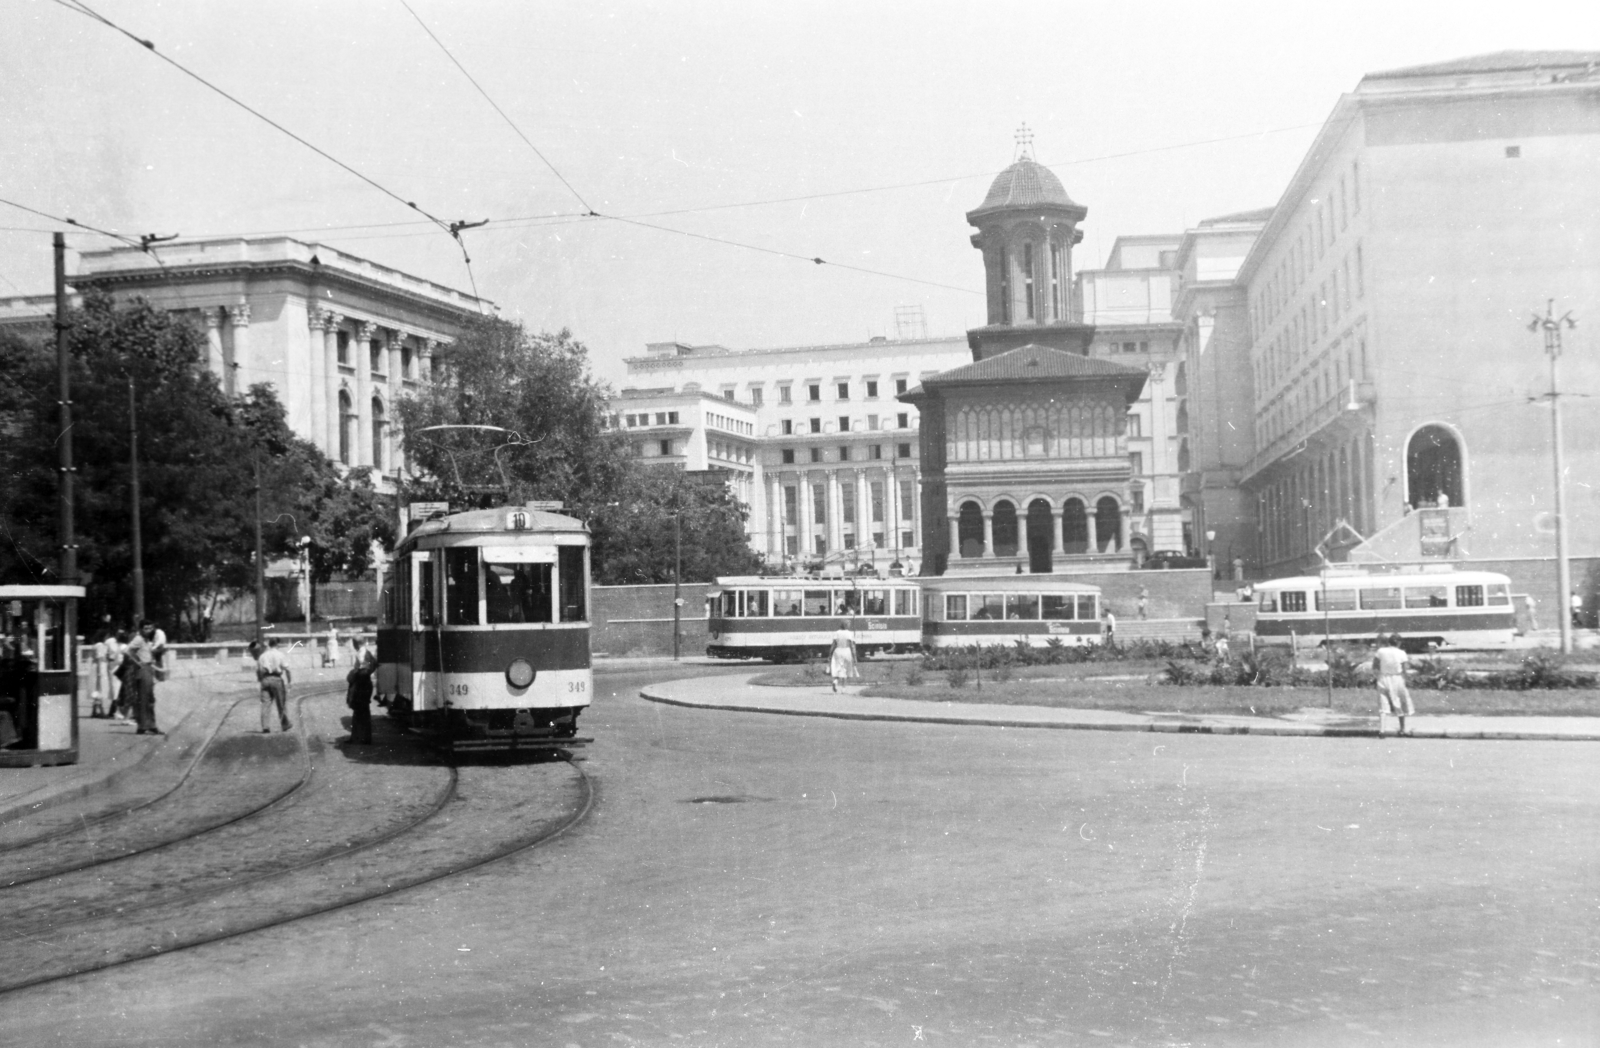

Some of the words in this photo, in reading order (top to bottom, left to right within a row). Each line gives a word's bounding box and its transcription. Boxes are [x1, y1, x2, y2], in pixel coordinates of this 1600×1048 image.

[513, 512, 526, 530] 10
[449, 684, 468, 695] 349
[568, 681, 585, 693] 349
